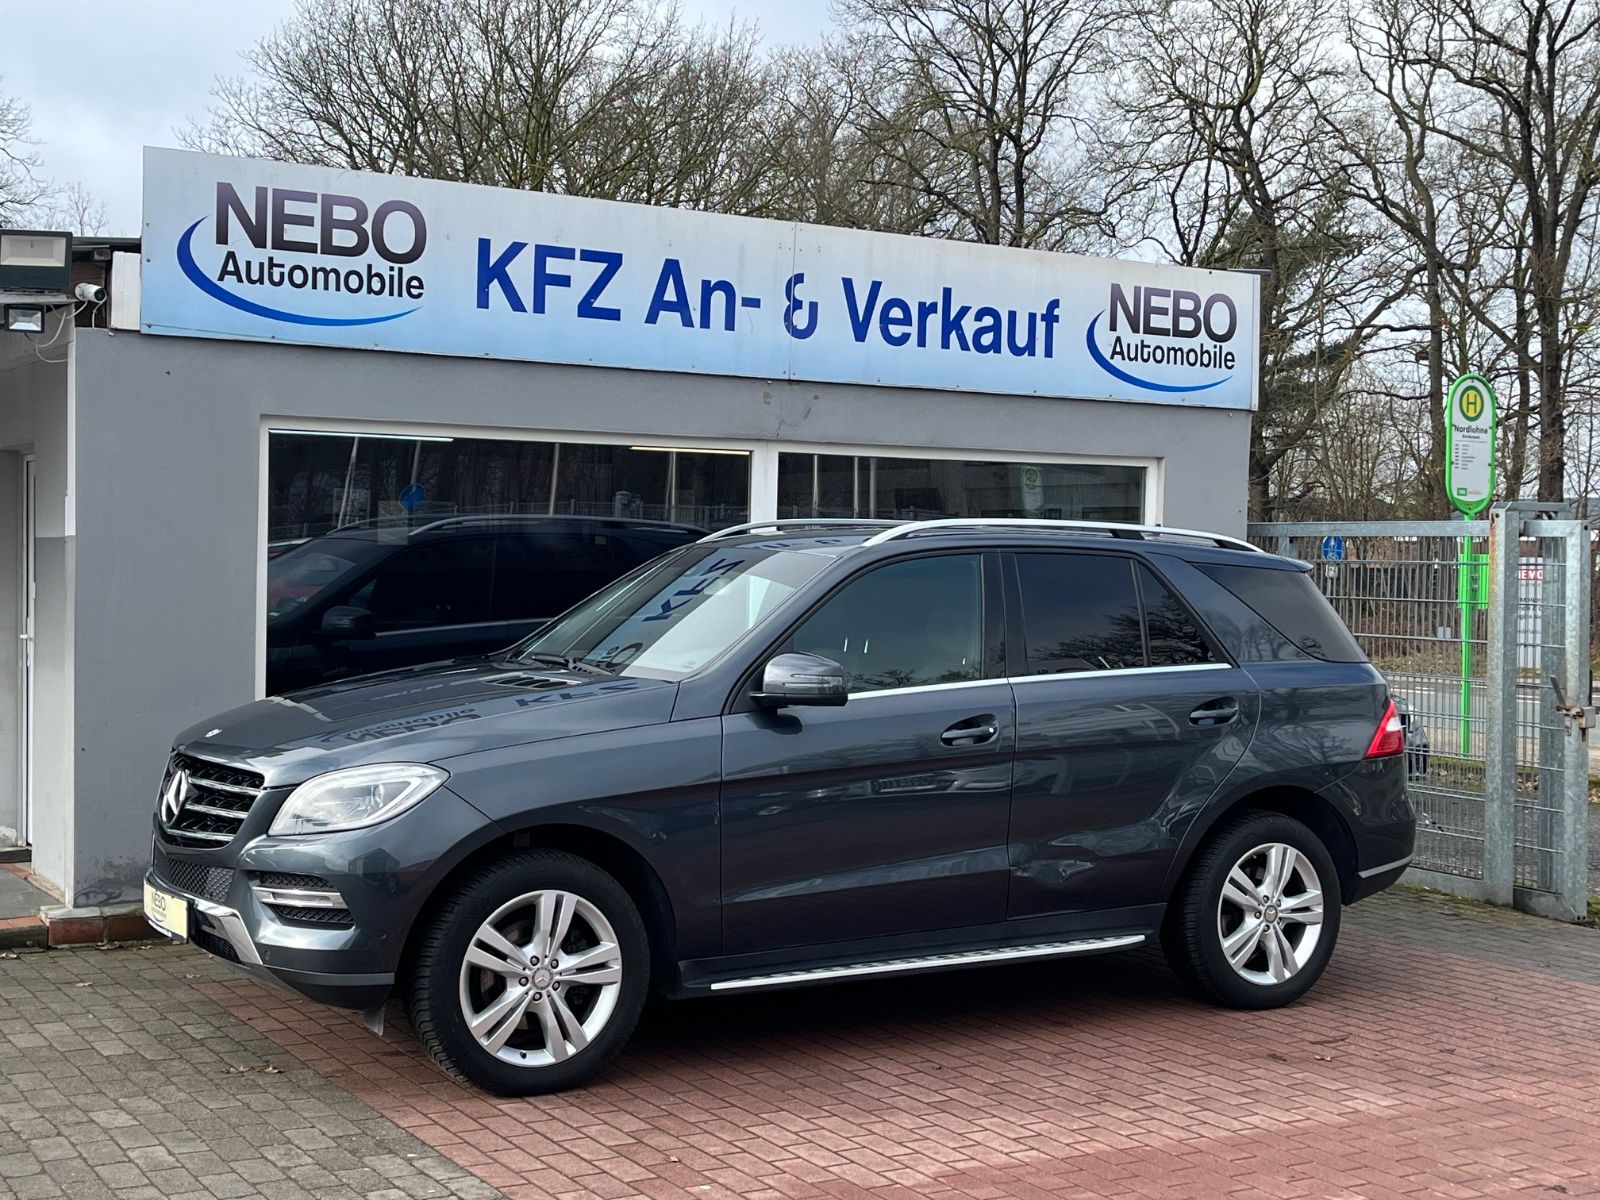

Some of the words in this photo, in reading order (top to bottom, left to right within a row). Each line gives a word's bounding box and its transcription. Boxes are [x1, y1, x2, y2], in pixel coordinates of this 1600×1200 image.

[215, 182, 427, 264] NEBO
[216, 250, 425, 301] Automobile
[476, 237, 624, 322] KFZ
[643, 257, 762, 332] An-
[783, 272, 819, 340] &
[841, 276, 1060, 359] Verkauf
[1109, 283, 1237, 344] NEBO
[1109, 335, 1236, 371] Automobile
[1454, 424, 1488, 435] Nordlohne
